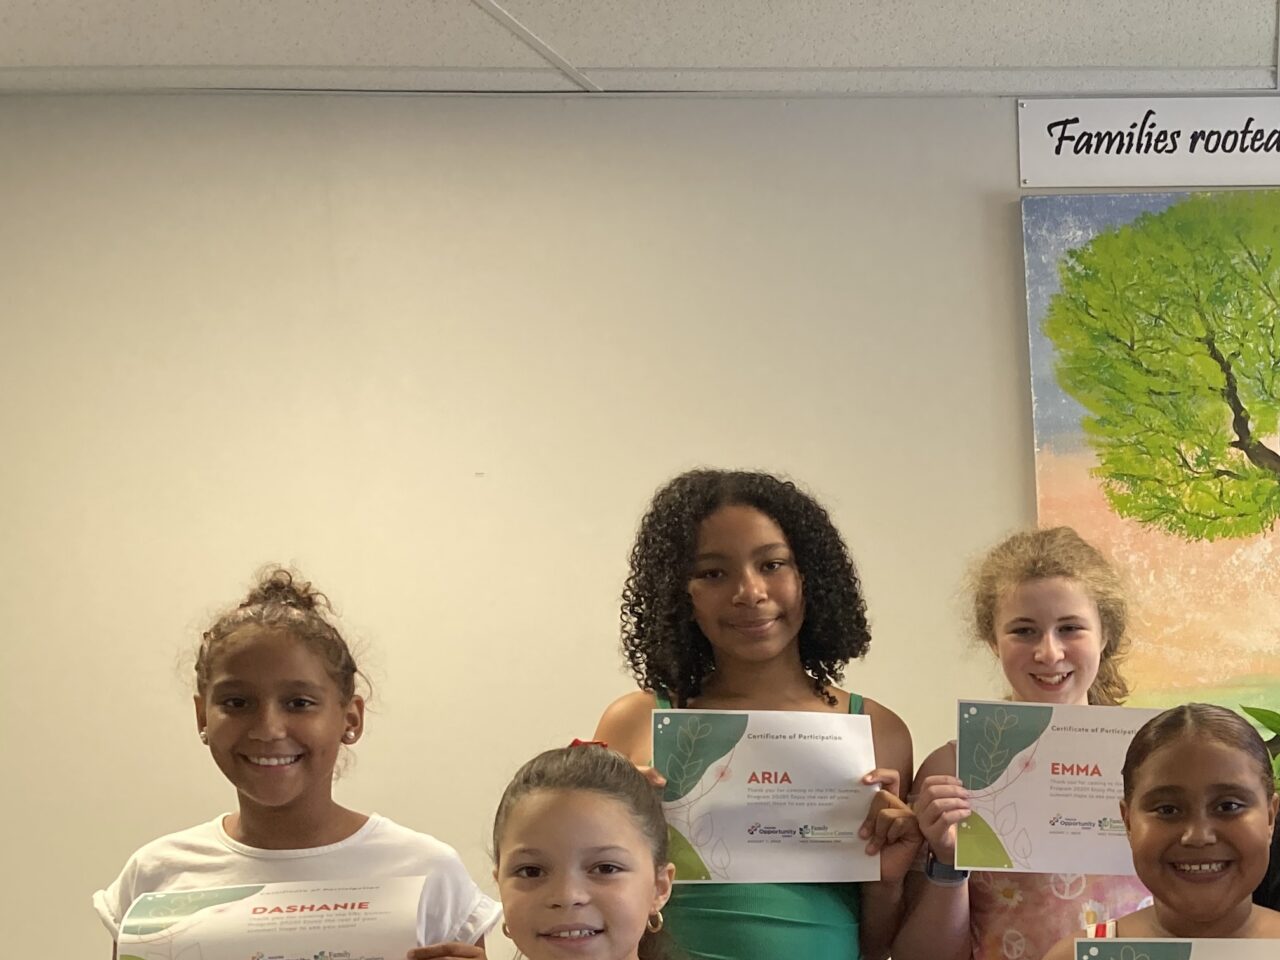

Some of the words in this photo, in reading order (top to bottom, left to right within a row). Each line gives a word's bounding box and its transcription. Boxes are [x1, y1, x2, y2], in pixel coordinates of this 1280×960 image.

[1047, 110, 1181, 155] Families
[1051, 762, 1102, 777] EMMA
[747, 771, 792, 784] ARIA
[252, 902, 369, 915] DASHANIE
